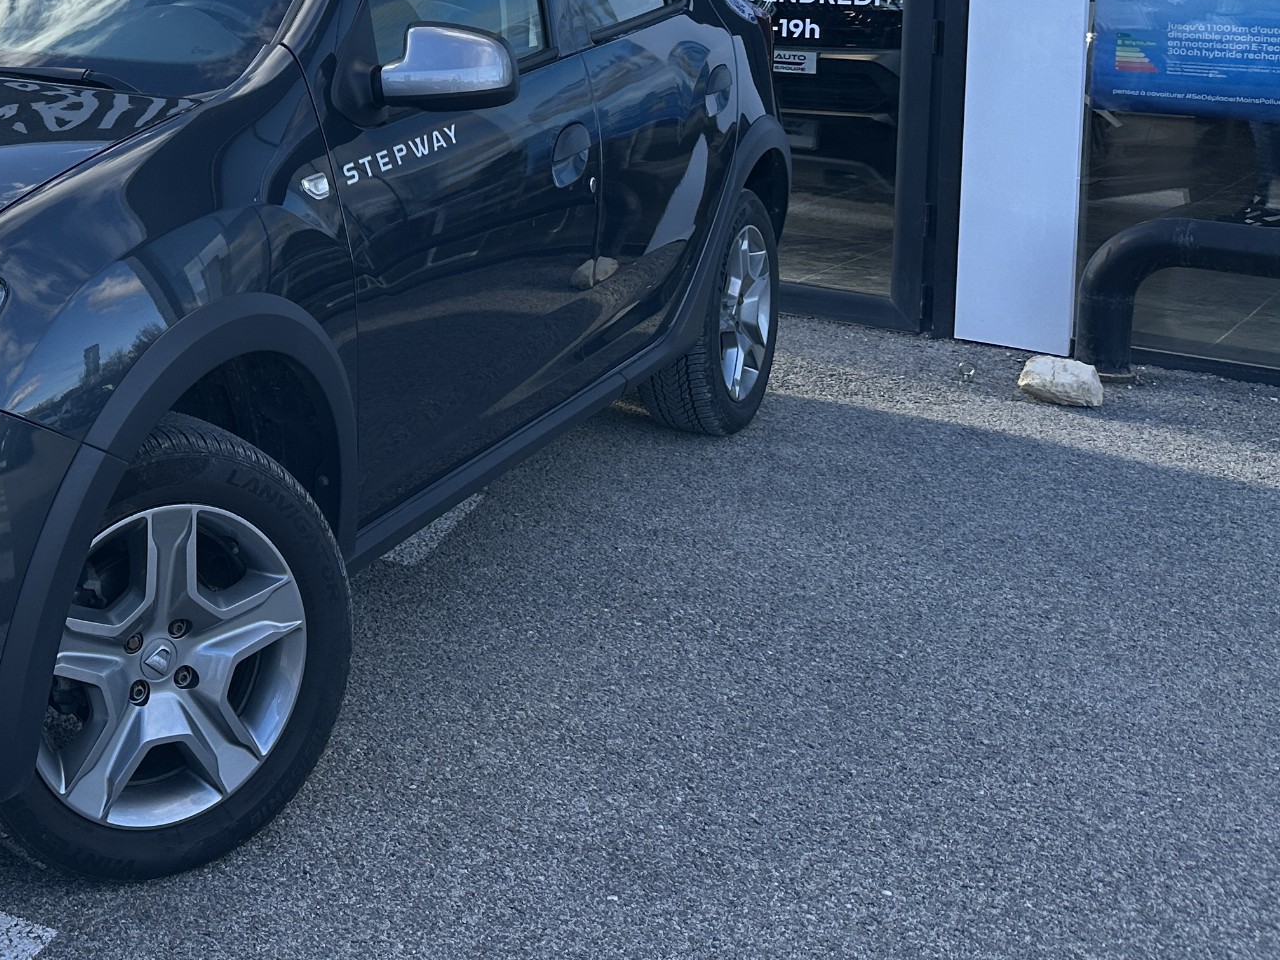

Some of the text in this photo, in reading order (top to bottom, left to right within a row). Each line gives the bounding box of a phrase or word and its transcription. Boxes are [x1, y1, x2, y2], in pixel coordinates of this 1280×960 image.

[1231, 23, 1249, 34] km
[1167, 31, 1222, 42] disponible
[1181, 40, 1250, 51] motorisation
[774, 53, 807, 61] AUTO
[1167, 48, 1187, 56] 300
[1187, 48, 1201, 57] ch
[1202, 48, 1242, 60] hybride
[343, 124, 457, 185] STEPWAY
